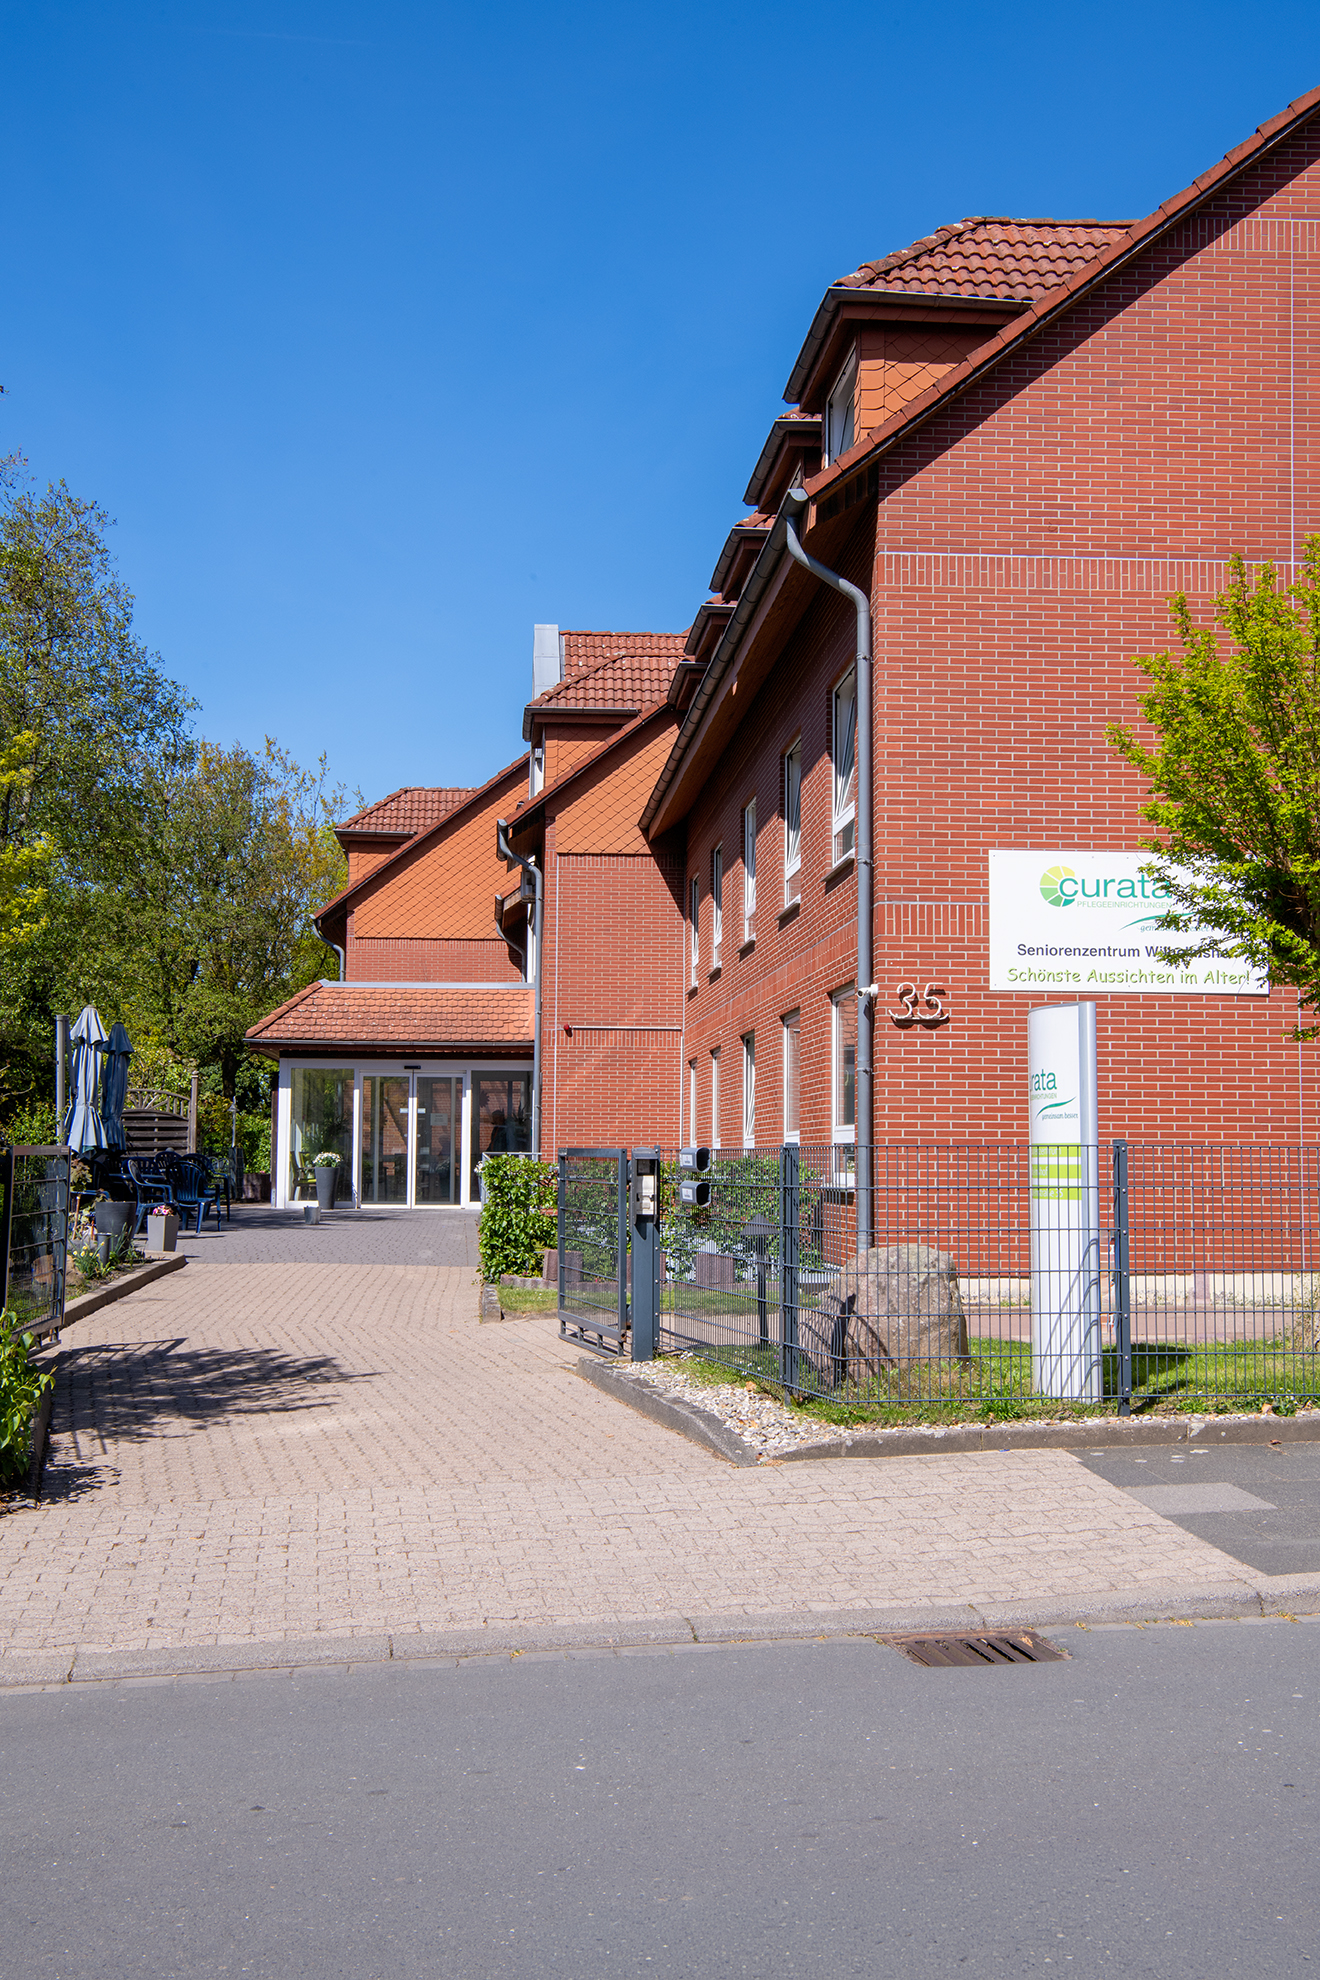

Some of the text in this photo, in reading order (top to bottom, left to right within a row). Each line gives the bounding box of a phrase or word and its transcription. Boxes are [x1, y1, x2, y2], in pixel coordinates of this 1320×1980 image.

[1059, 874, 1172, 899] curata
[1076, 901, 1172, 909] PFLEGEEINRICHTUNGEN
[1017, 943, 1140, 957] Seniorenzentrum
[1007, 967, 1250, 985] Schönste Aussichten im Alter!
[888, 981, 950, 1020] 35
[1031, 1068, 1058, 1091] rata
